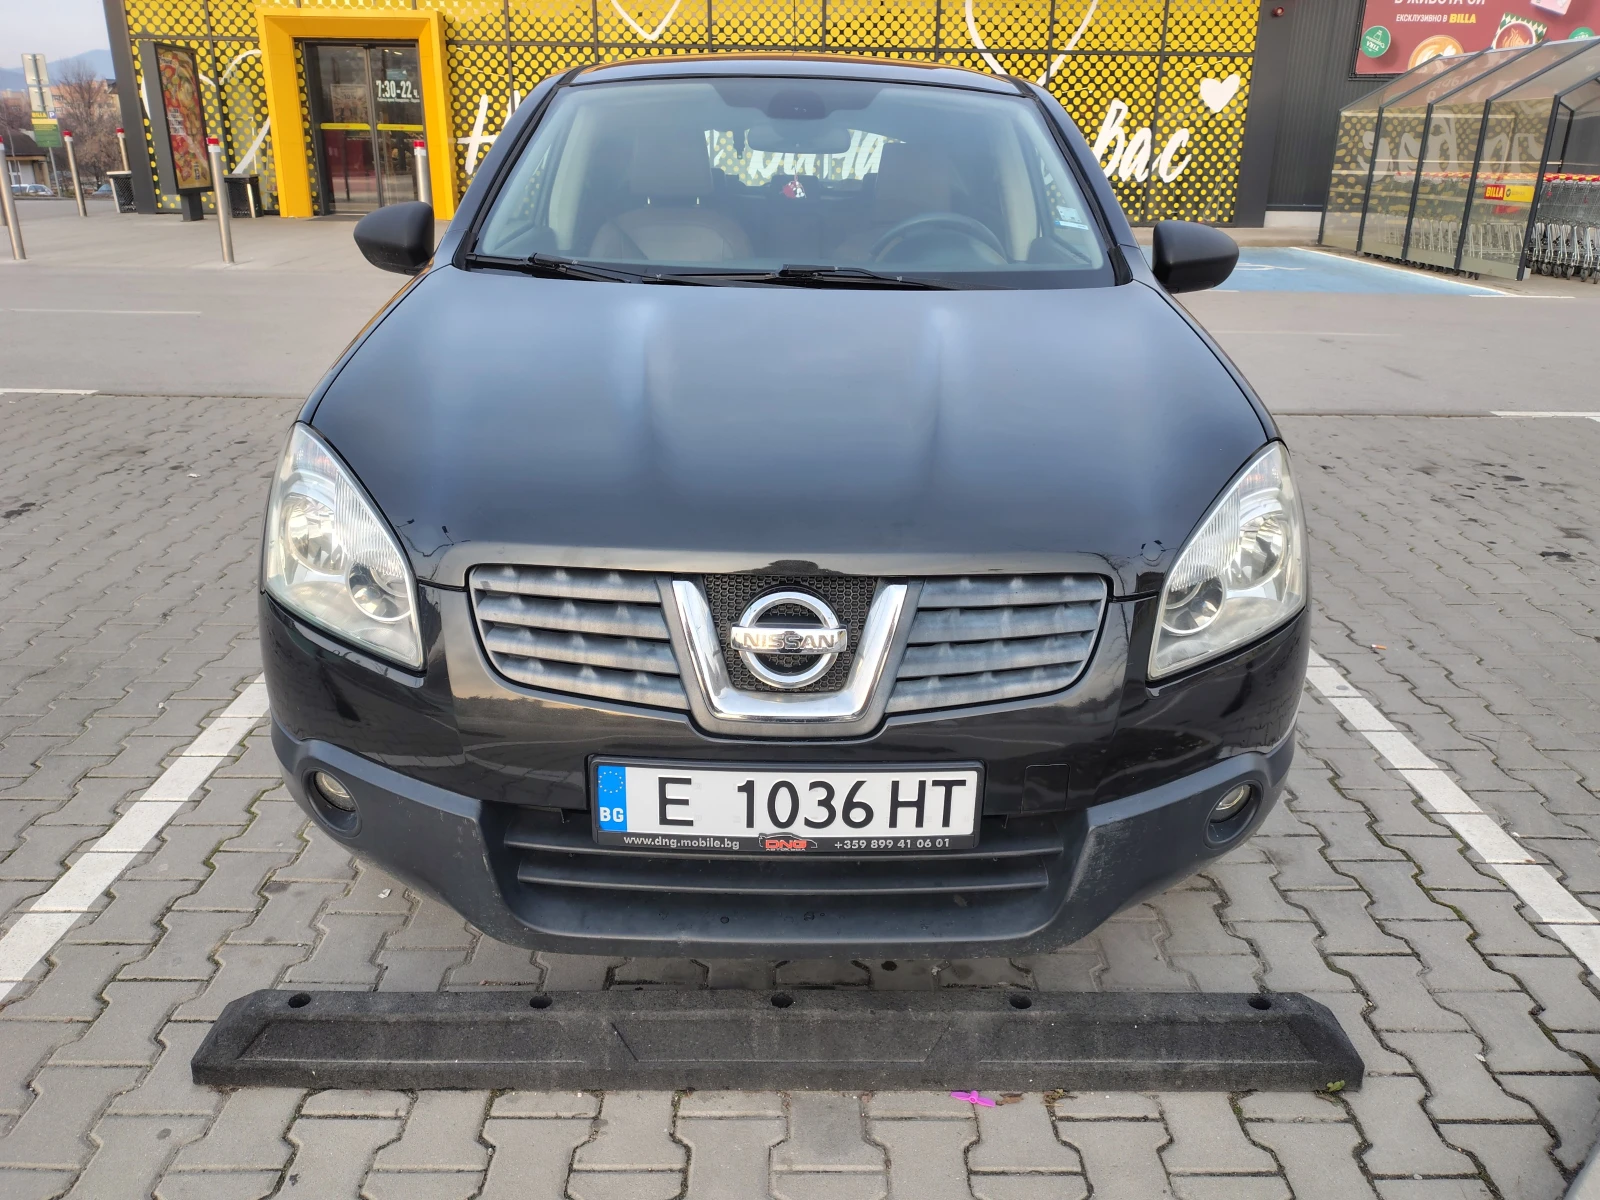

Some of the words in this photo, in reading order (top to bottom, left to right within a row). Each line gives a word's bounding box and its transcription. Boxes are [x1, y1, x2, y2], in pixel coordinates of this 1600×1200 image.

[1396, 14, 1442, 23] ЕКСКЛУЗИВНО
[1442, 14, 1448, 23] В
[1449, 13, 1477, 24] BILLA
[375, 80, 412, 98] 7:30-22
[1485, 186, 1504, 198] BILLA
[743, 632, 835, 650] NISSAN
[658, 777, 694, 827] E
[737, 780, 875, 830] 1036
[889, 779, 967, 830] HT
[600, 806, 625, 823] BG
[623, 836, 740, 850] www.dng.mobile.bg
[765, 839, 807, 849] DNG
[834, 840, 867, 850] +359
[871, 840, 893, 849] 899
[897, 839, 912, 849] 41
[916, 839, 932, 848] 06
[935, 838, 950, 848] 01
